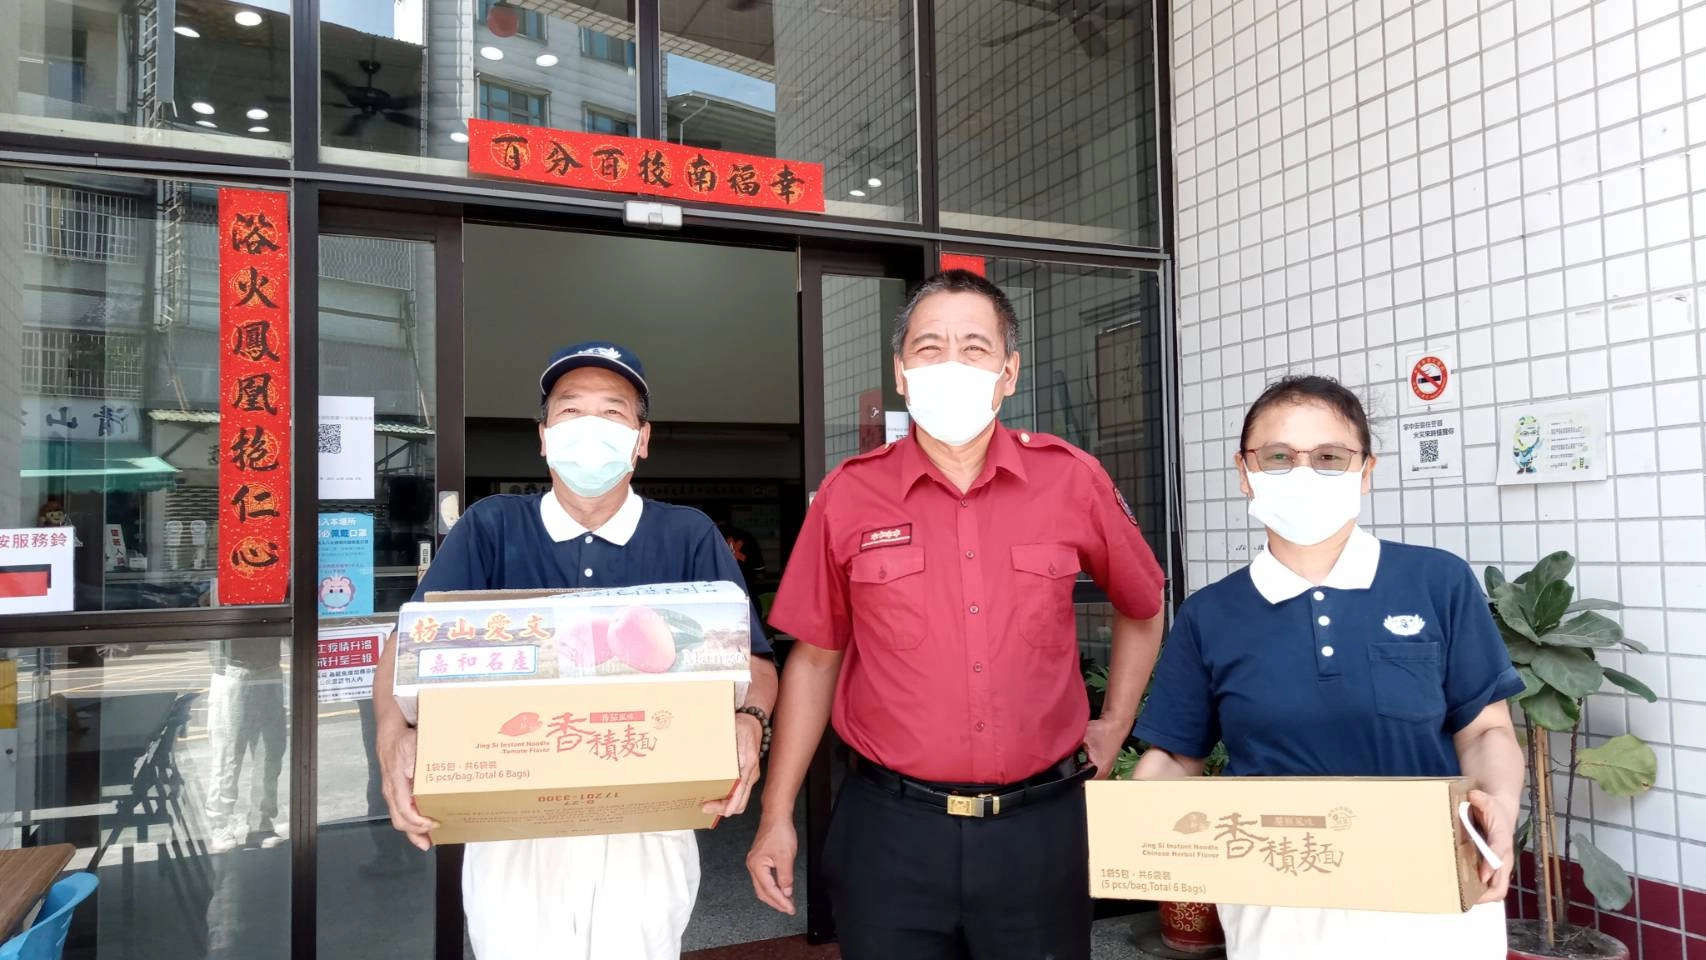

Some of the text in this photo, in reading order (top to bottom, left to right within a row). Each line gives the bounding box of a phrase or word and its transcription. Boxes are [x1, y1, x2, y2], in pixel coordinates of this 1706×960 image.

[231, 213, 281, 567] 浴火鳳凰抱仁心
[410, 612, 552, 643] 枋山愛文
[429, 651, 532, 675] 嘉和名產
[546, 712, 658, 761] 香積麵
[425, 774, 434, 783] (5
[506, 770, 531, 779] Bags)
[1214, 812, 1344, 877] 香積麵
[1101, 880, 1110, 889] (5
[1173, 883, 1178, 892] 6
[1181, 883, 1206, 895] Bags)
